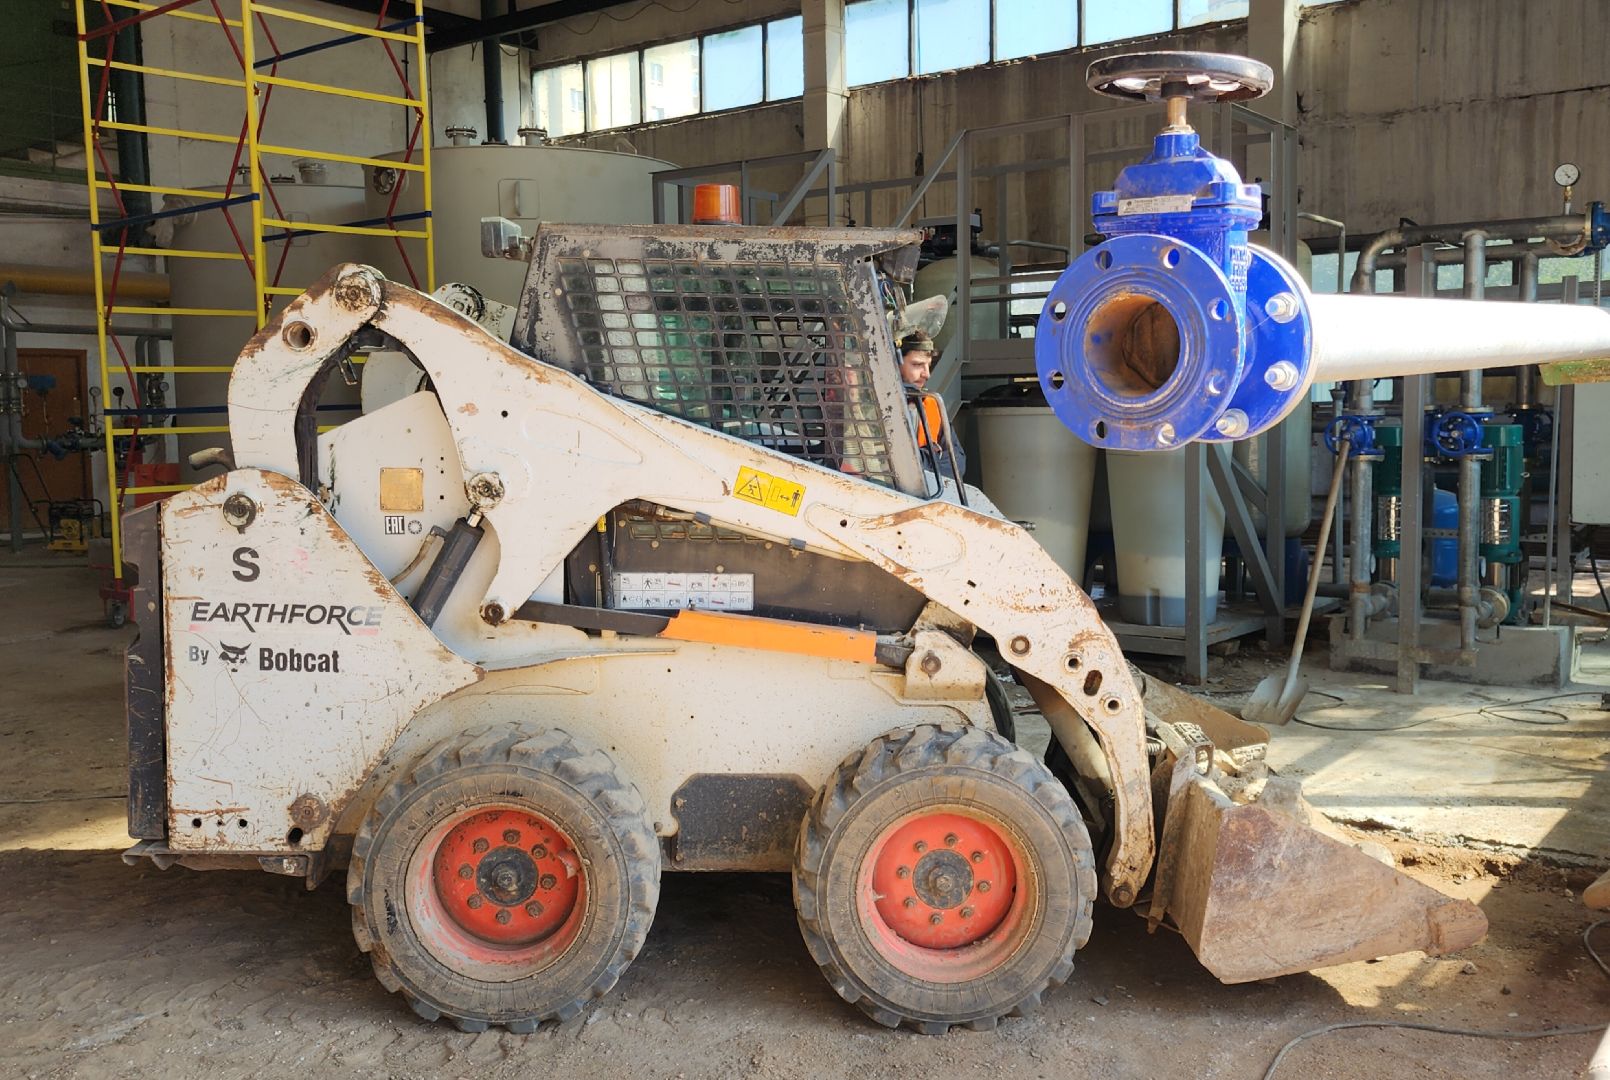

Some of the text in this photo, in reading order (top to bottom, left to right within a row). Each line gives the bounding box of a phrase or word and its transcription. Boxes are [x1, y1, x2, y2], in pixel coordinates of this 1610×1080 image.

[232, 547, 260, 582] S
[191, 602, 384, 635] EARTHFORCE
[189, 645, 340, 673] By Bobcat
